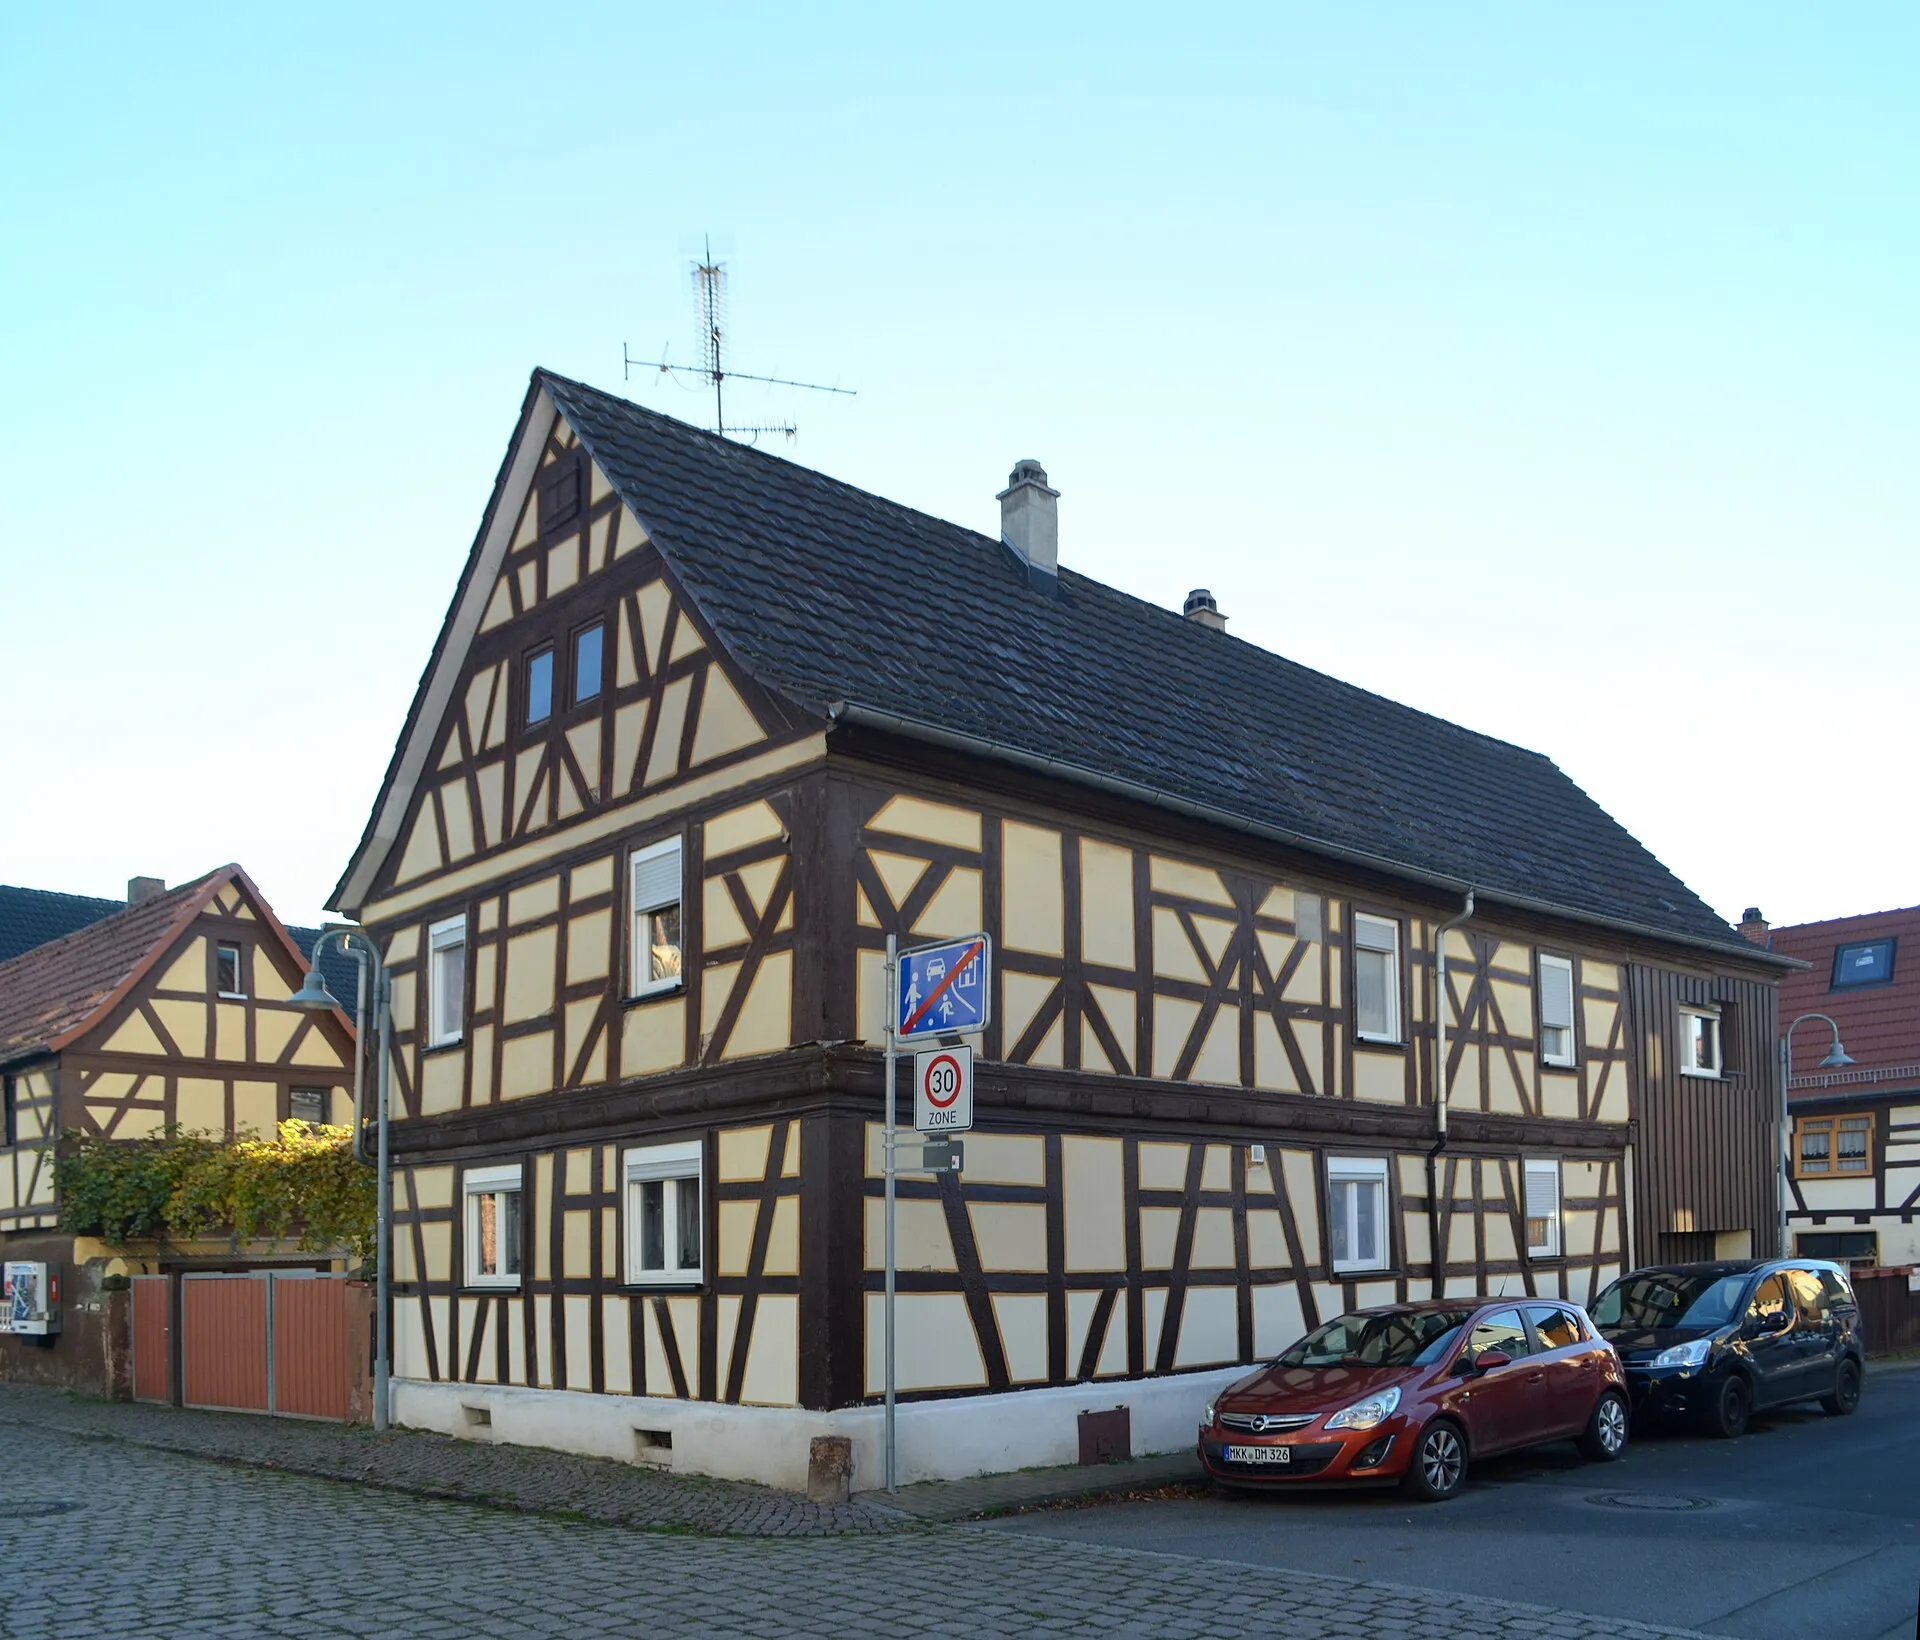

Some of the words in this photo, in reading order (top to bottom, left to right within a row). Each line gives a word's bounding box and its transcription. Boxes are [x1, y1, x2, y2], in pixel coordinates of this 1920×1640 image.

[932, 1069, 954, 1093] 30
[928, 1110, 957, 1125] ZONE
[1230, 1447, 1247, 1460] MKK
[1255, 1448, 1268, 1460] DM
[1269, 1448, 1289, 1461] 326
